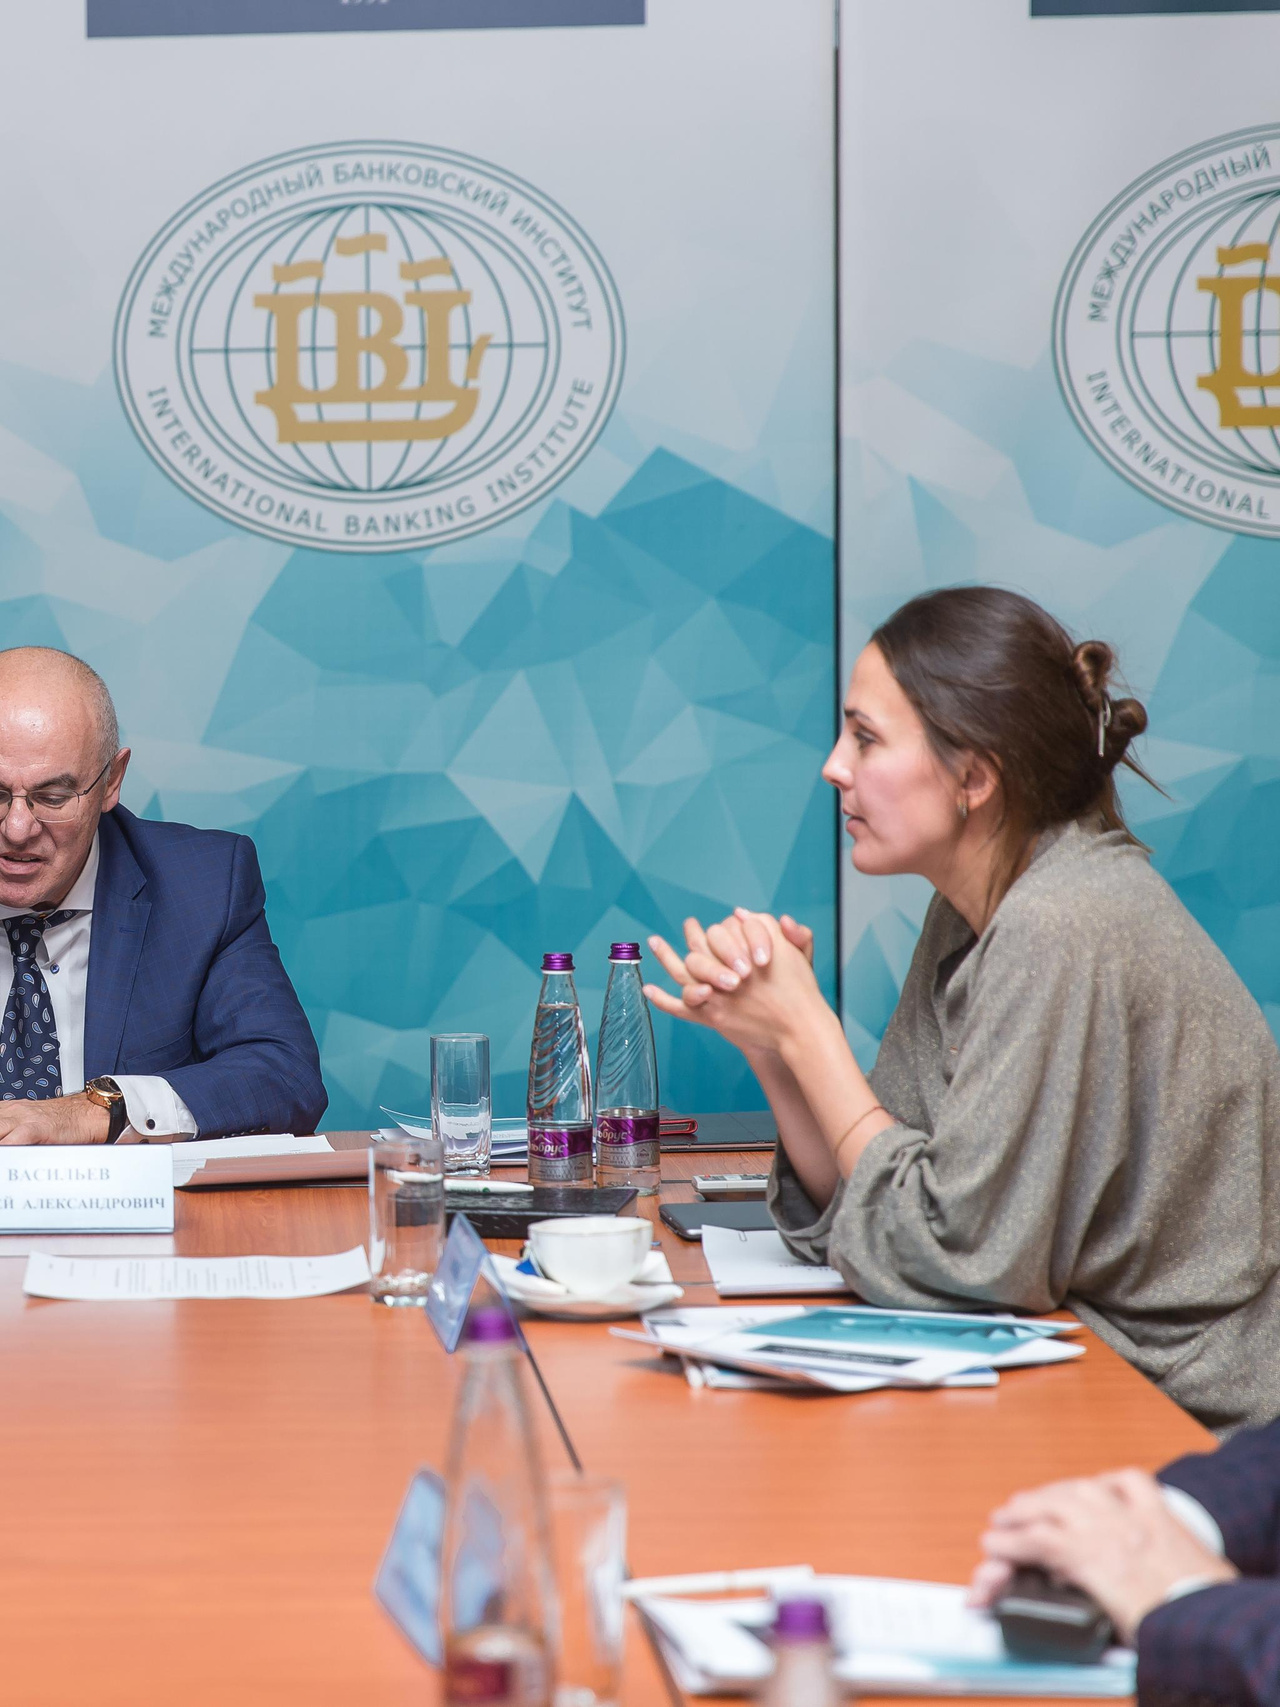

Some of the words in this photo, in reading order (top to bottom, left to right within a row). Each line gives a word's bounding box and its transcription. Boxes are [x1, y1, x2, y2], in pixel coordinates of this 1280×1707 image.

[147, 161, 324, 340] МЕЖДУНАРОДНЫЙ
[332, 161, 511, 217] БАНКОВСКИЙ
[510, 207, 595, 332] ИНСТИТУТ
[1087, 142, 1272, 323] МЕЖДУНАРОДНЫЙ
[146, 385, 329, 533] INTERNATIONAL
[344, 497, 477, 537] BANKING
[485, 377, 594, 504] INSTITUTE
[1086, 370, 1271, 519] INTERNATIONAL
[7, 1167, 111, 1182] ВАСИЛЬЕВ
[22, 1196, 166, 1211] АЛЕКСАНДРОВИЧ
